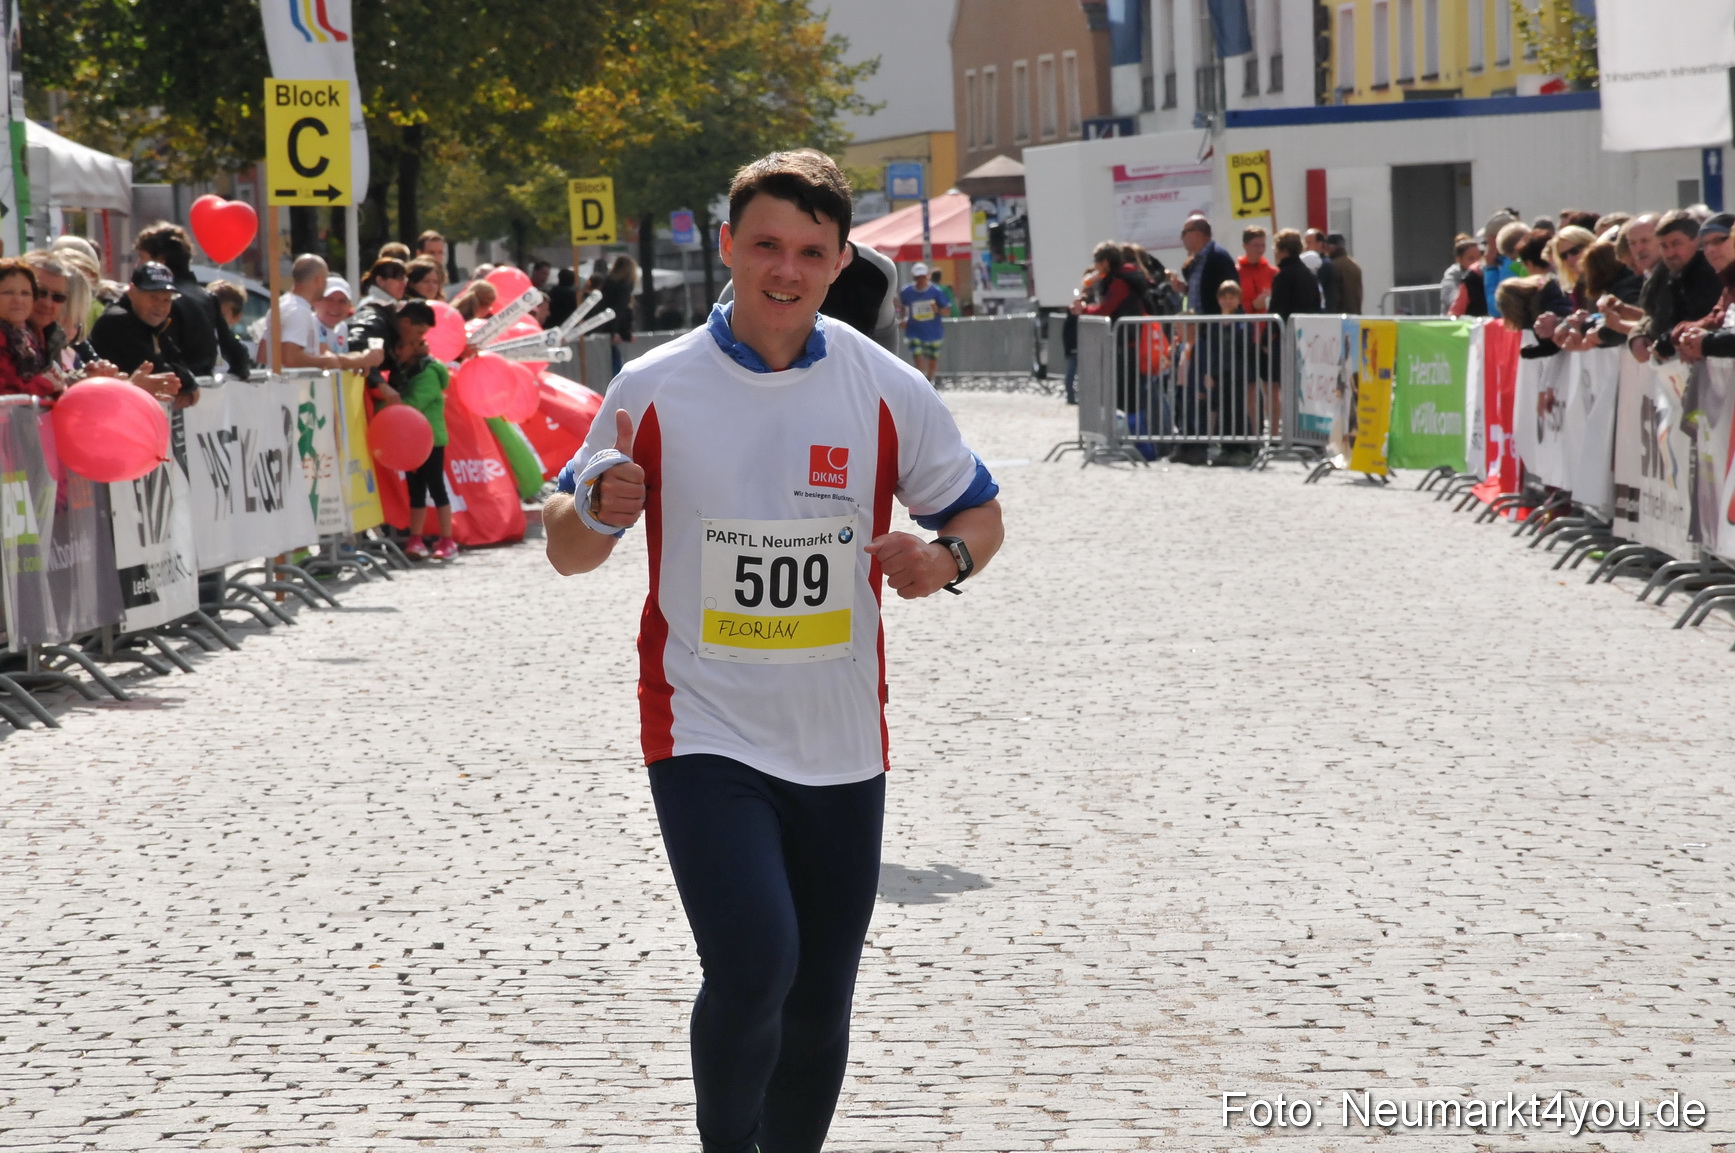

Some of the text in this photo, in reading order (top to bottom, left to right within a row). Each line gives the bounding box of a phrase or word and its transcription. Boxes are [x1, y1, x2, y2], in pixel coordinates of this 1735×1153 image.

[275, 84, 341, 107] Block
[287, 116, 330, 178] C
[1231, 154, 1266, 168] Block
[574, 181, 607, 194] Block
[1240, 172, 1263, 204] D
[581, 198, 604, 231] D
[812, 471, 845, 485] DKMS
[793, 489, 804, 497] Wir
[805, 491, 831, 500] besiegen
[706, 529, 833, 548] PARTL Neumarkt
[734, 553, 830, 609] 509
[718, 619, 800, 640] FLORIAN
